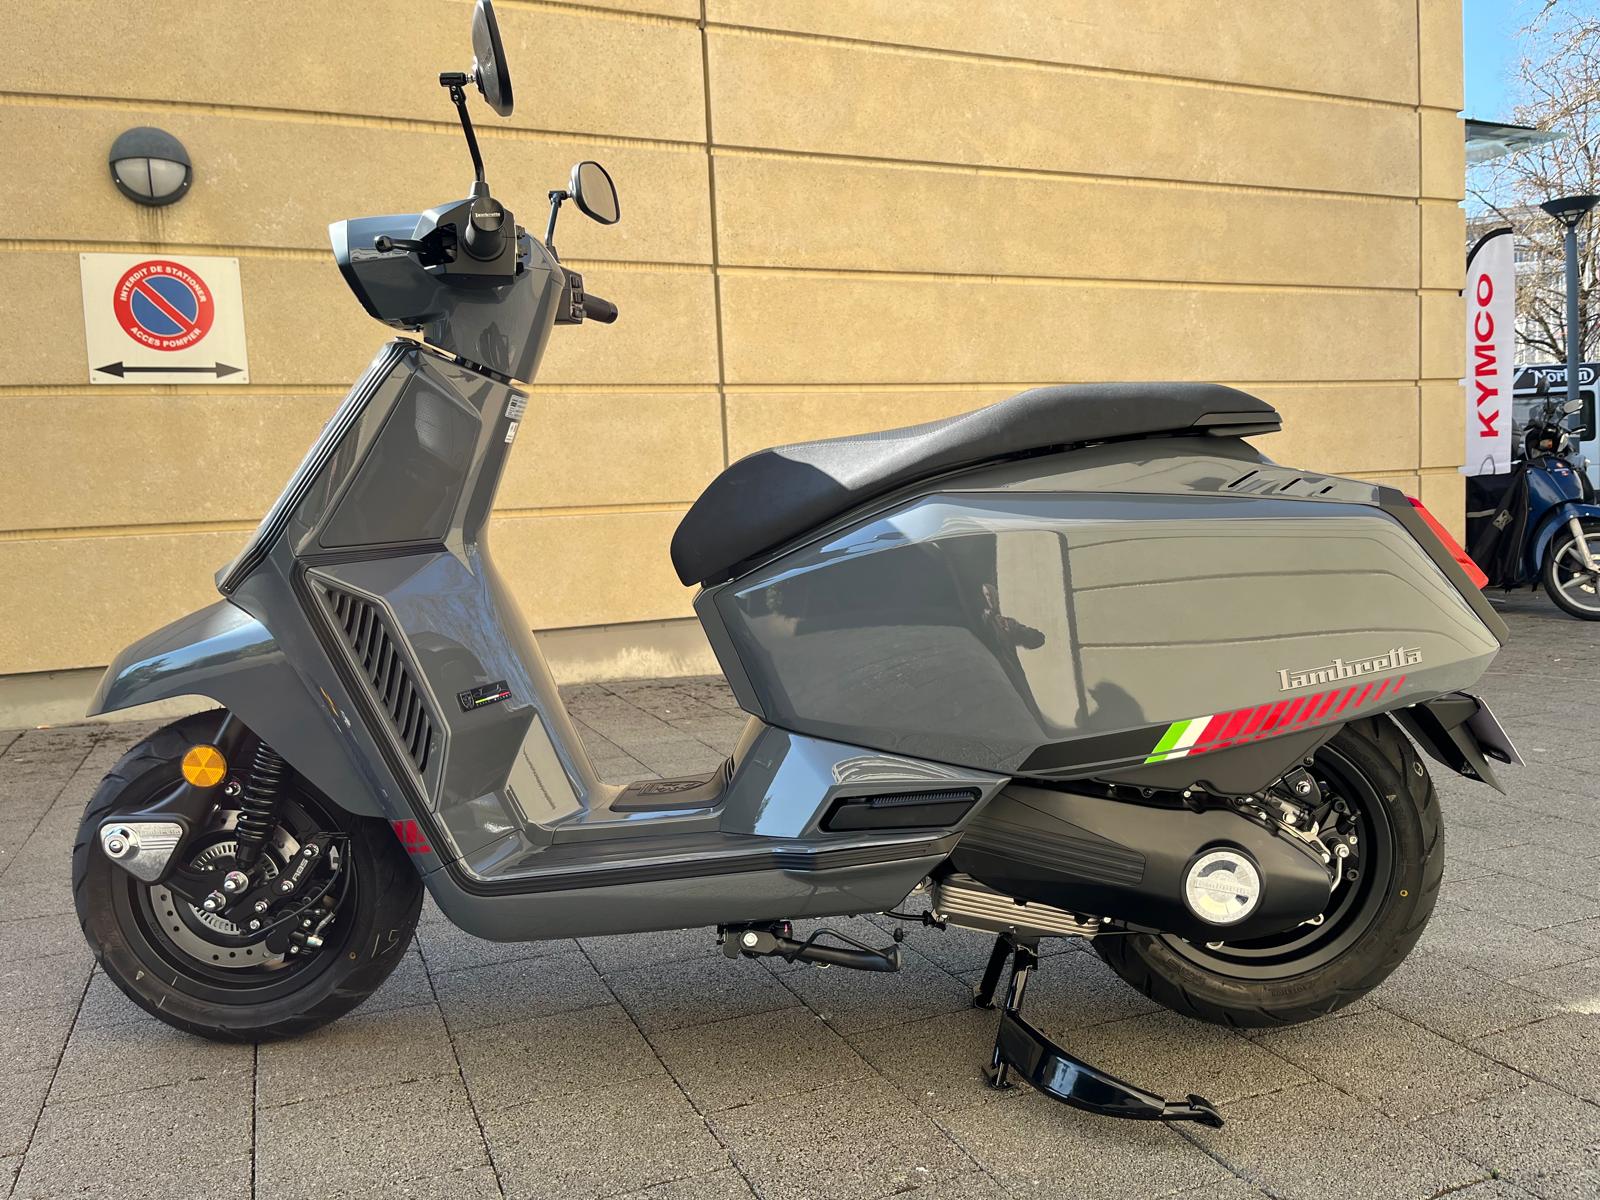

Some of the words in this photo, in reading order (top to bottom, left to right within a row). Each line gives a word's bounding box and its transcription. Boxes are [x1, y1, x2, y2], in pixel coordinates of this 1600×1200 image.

[120, 267, 148, 302] INTERDIT
[150, 265, 163, 273] DE
[165, 266, 207, 303] STATIONER
[130, 326, 161, 347] ACCES
[162, 327, 202, 348] POMPIER
[1474, 273, 1500, 438] KYMCO
[1277, 646, 1423, 692] Lambretta
